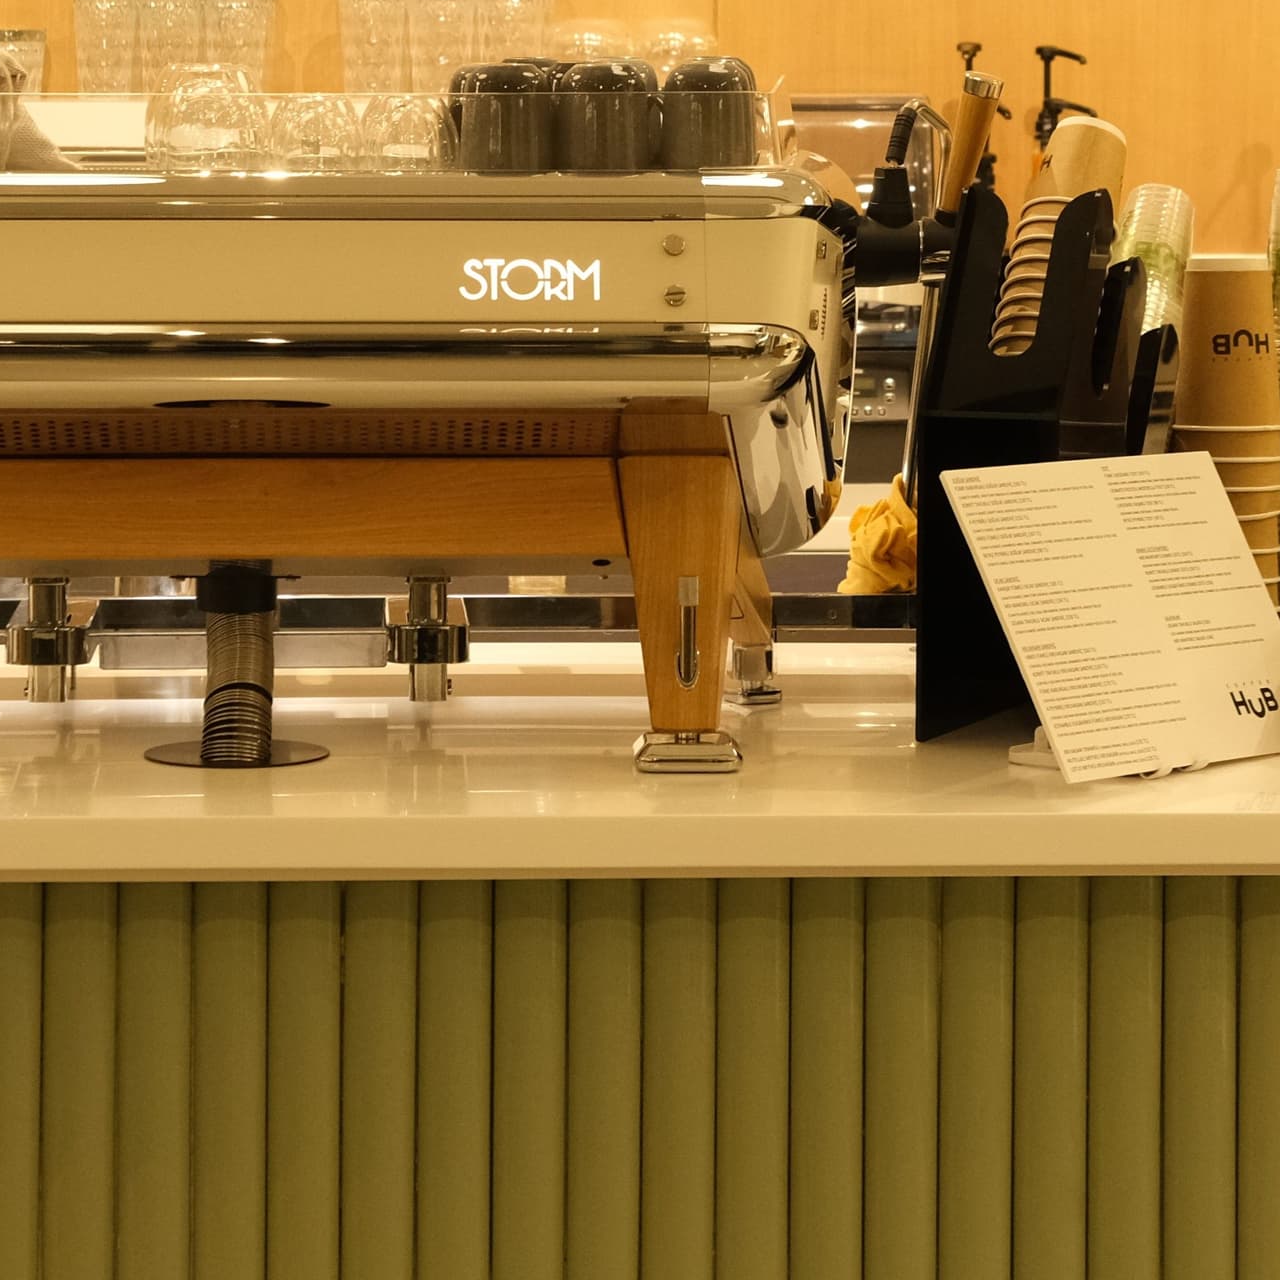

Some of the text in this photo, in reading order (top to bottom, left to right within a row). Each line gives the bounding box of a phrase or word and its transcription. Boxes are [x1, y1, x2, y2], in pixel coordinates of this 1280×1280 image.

[459, 258, 600, 301] STORM
[1212, 329, 1269, 355] HUB
[1230, 687, 1279, 718] HUB
